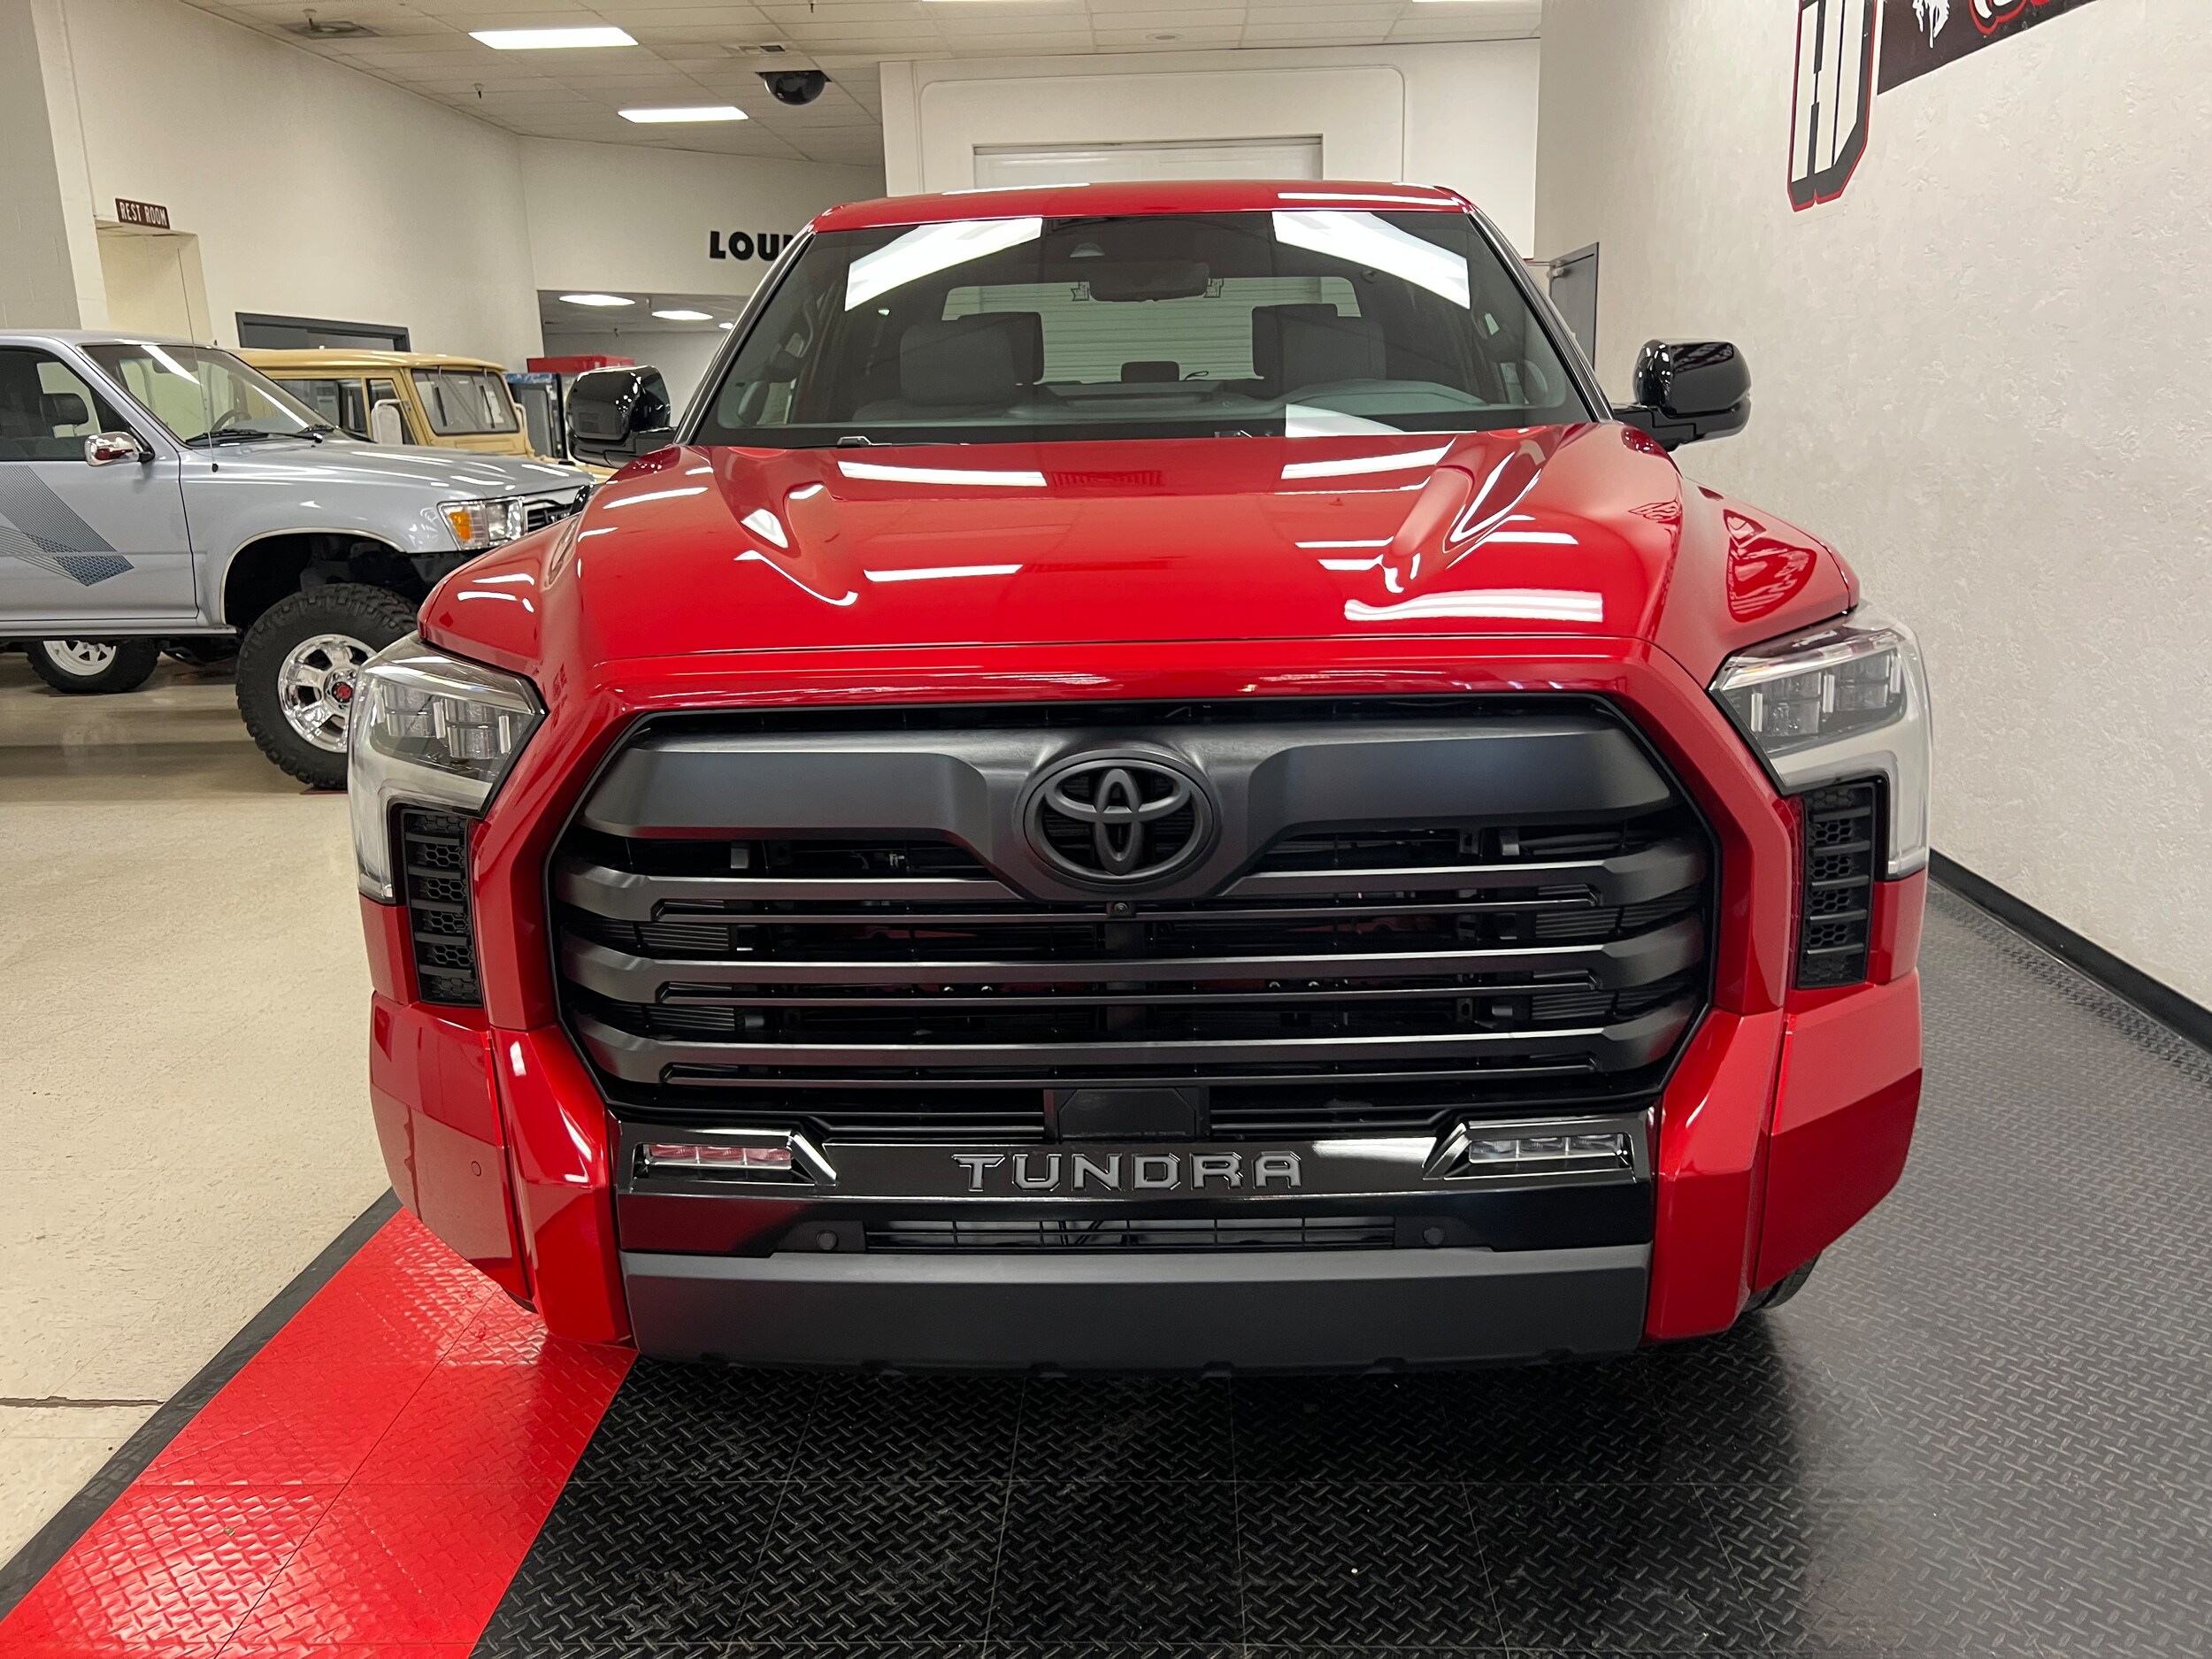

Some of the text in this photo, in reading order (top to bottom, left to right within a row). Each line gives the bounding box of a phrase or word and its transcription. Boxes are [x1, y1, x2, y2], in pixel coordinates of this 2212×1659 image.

[119, 202, 167, 226] REST ROOM
[952, 1152, 1302, 1191] TUNDRA
